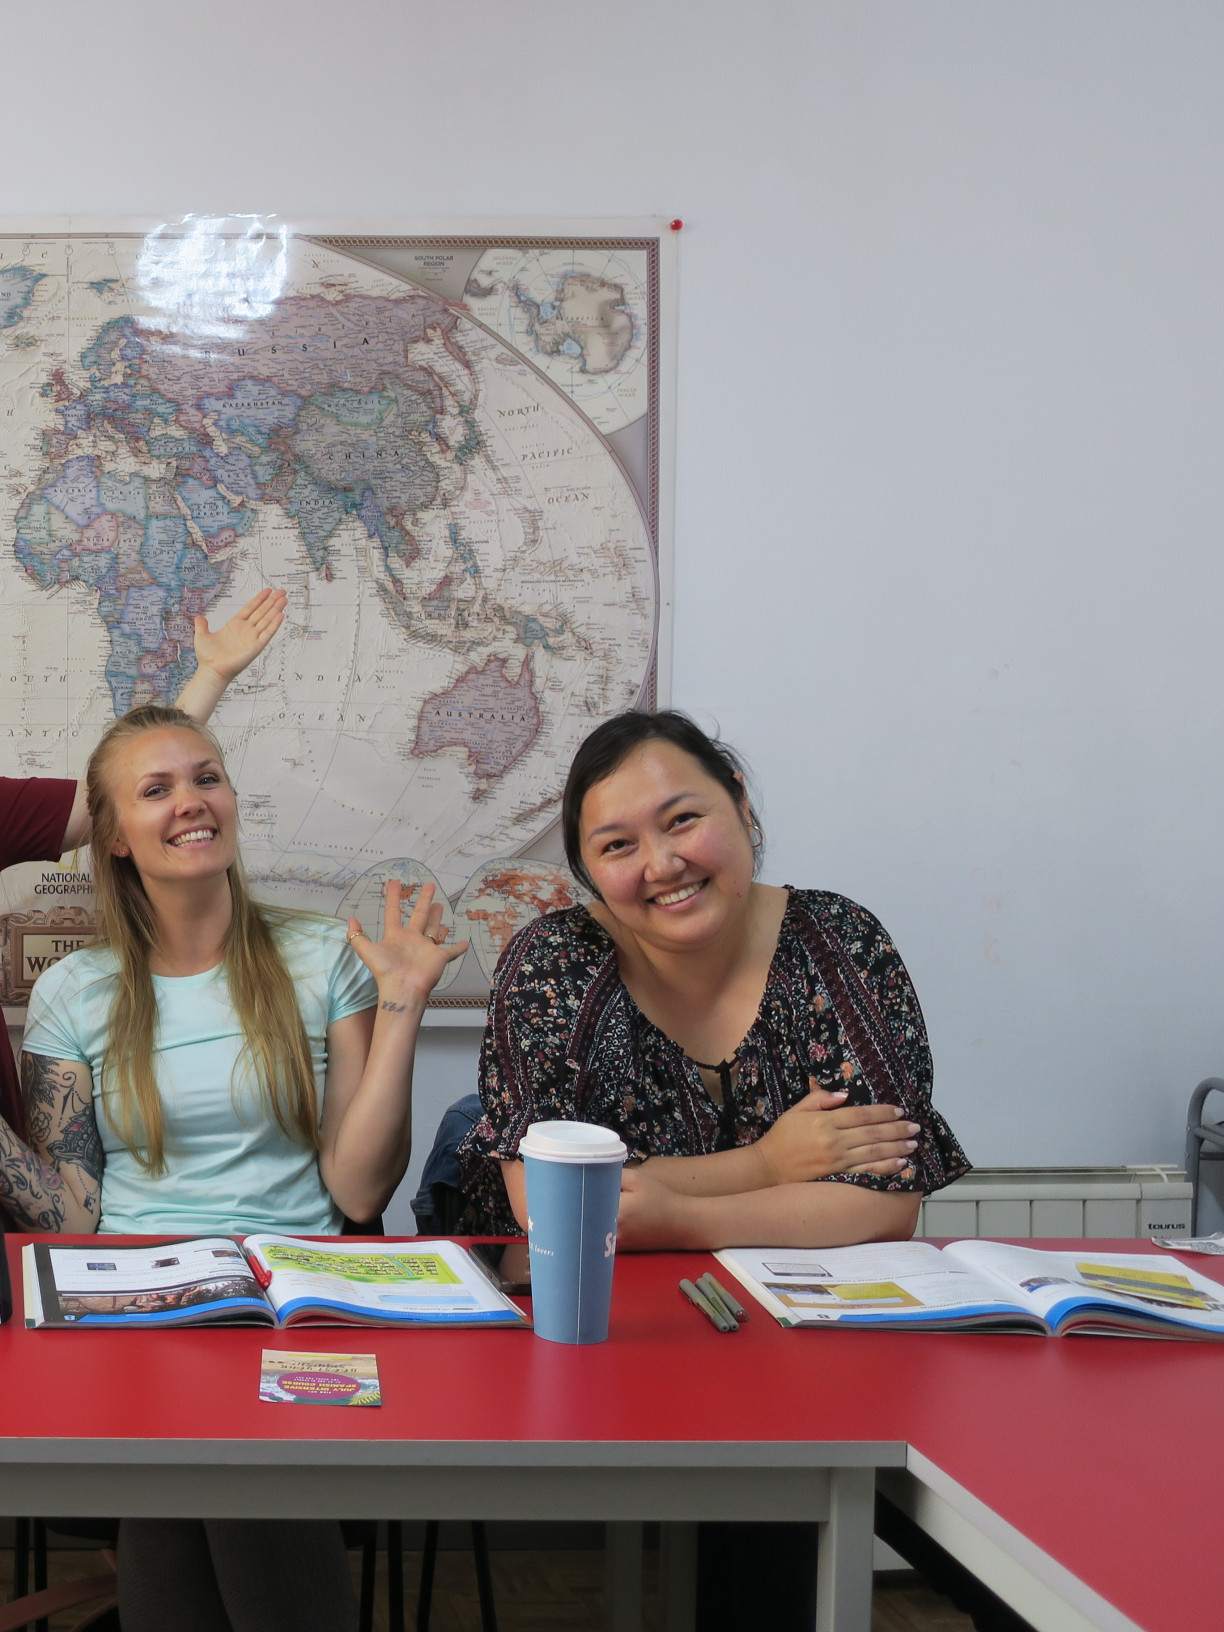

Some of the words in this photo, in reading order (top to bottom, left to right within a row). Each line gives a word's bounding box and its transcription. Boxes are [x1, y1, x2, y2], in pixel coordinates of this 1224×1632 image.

[498, 403, 540, 418] NORTH
[329, 450, 399, 460] CHINA
[521, 448, 573, 461] PACIFIC
[547, 492, 589, 504] OCEAN
[278, 673, 384, 683] INDIAN
[279, 712, 367, 722] OCEAN
[435, 710, 526, 722] AUSTRALIA
[41, 872, 93, 883] NATIONAL
[34, 884, 93, 894] GEOGRAPHI
[51, 940, 84, 953] THE
[534, 1244, 554, 1256] lovers
